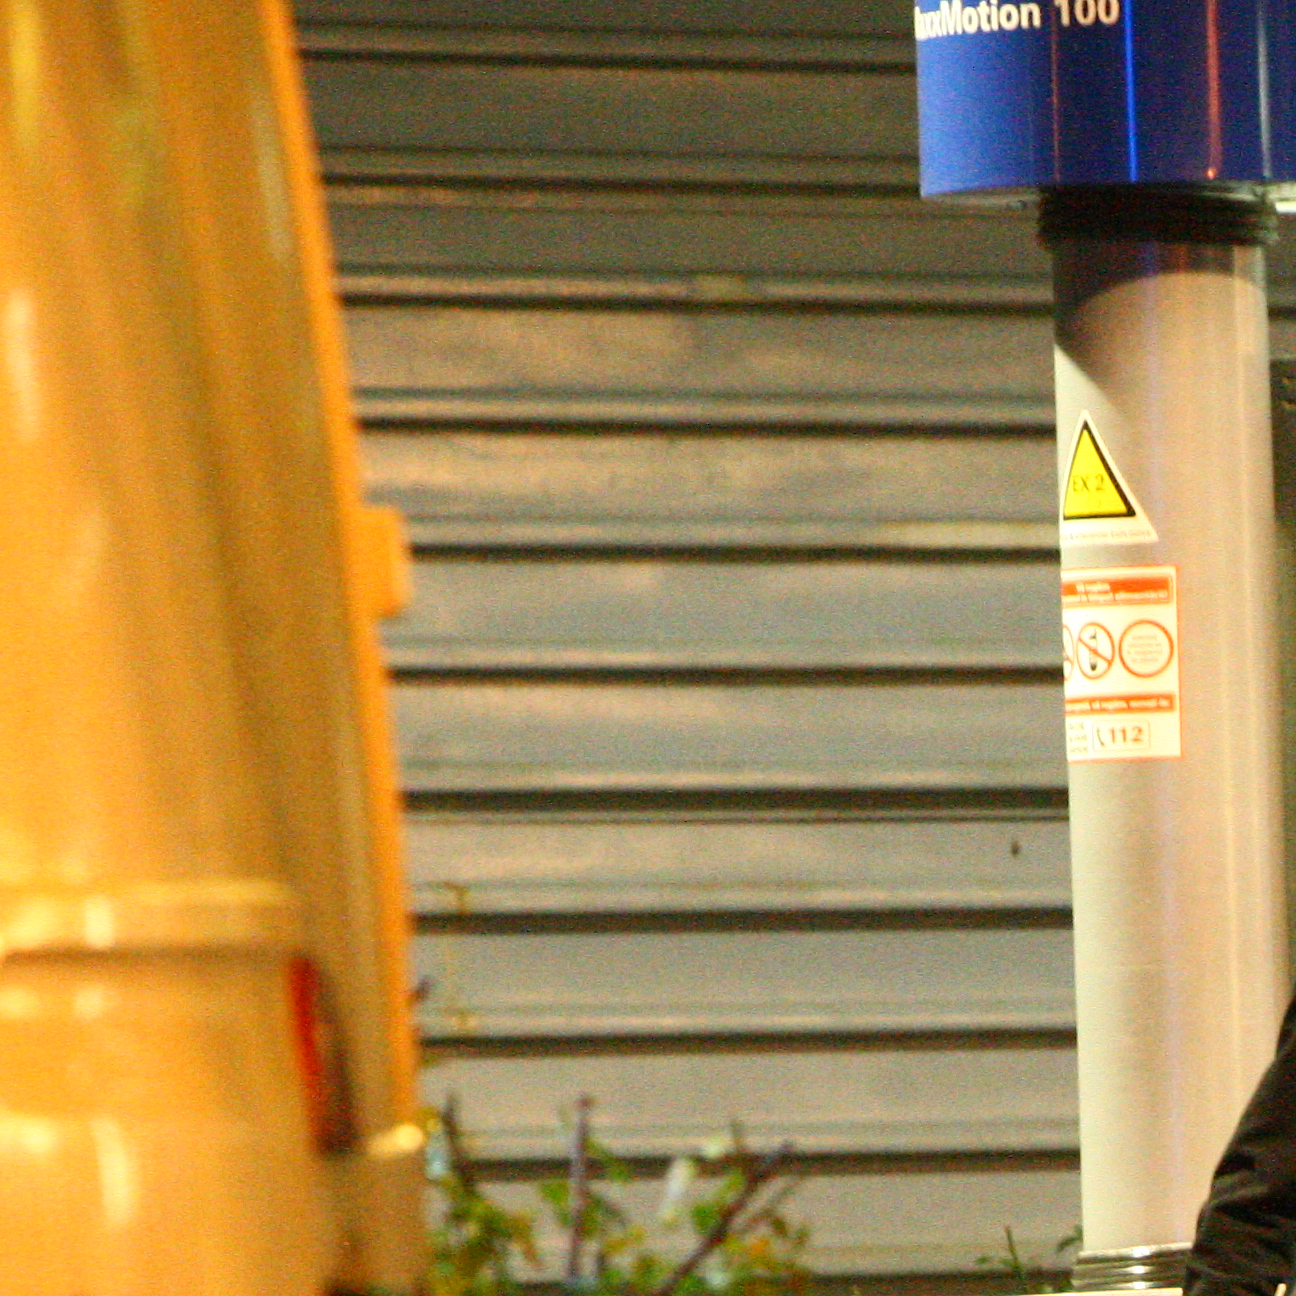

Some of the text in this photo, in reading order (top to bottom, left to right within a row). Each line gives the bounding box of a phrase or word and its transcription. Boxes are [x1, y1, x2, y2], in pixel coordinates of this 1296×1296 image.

[1055, 0, 1120, 26] 100
[1094, 473, 1106, 492] 2
[1109, 725, 1144, 744] 112
